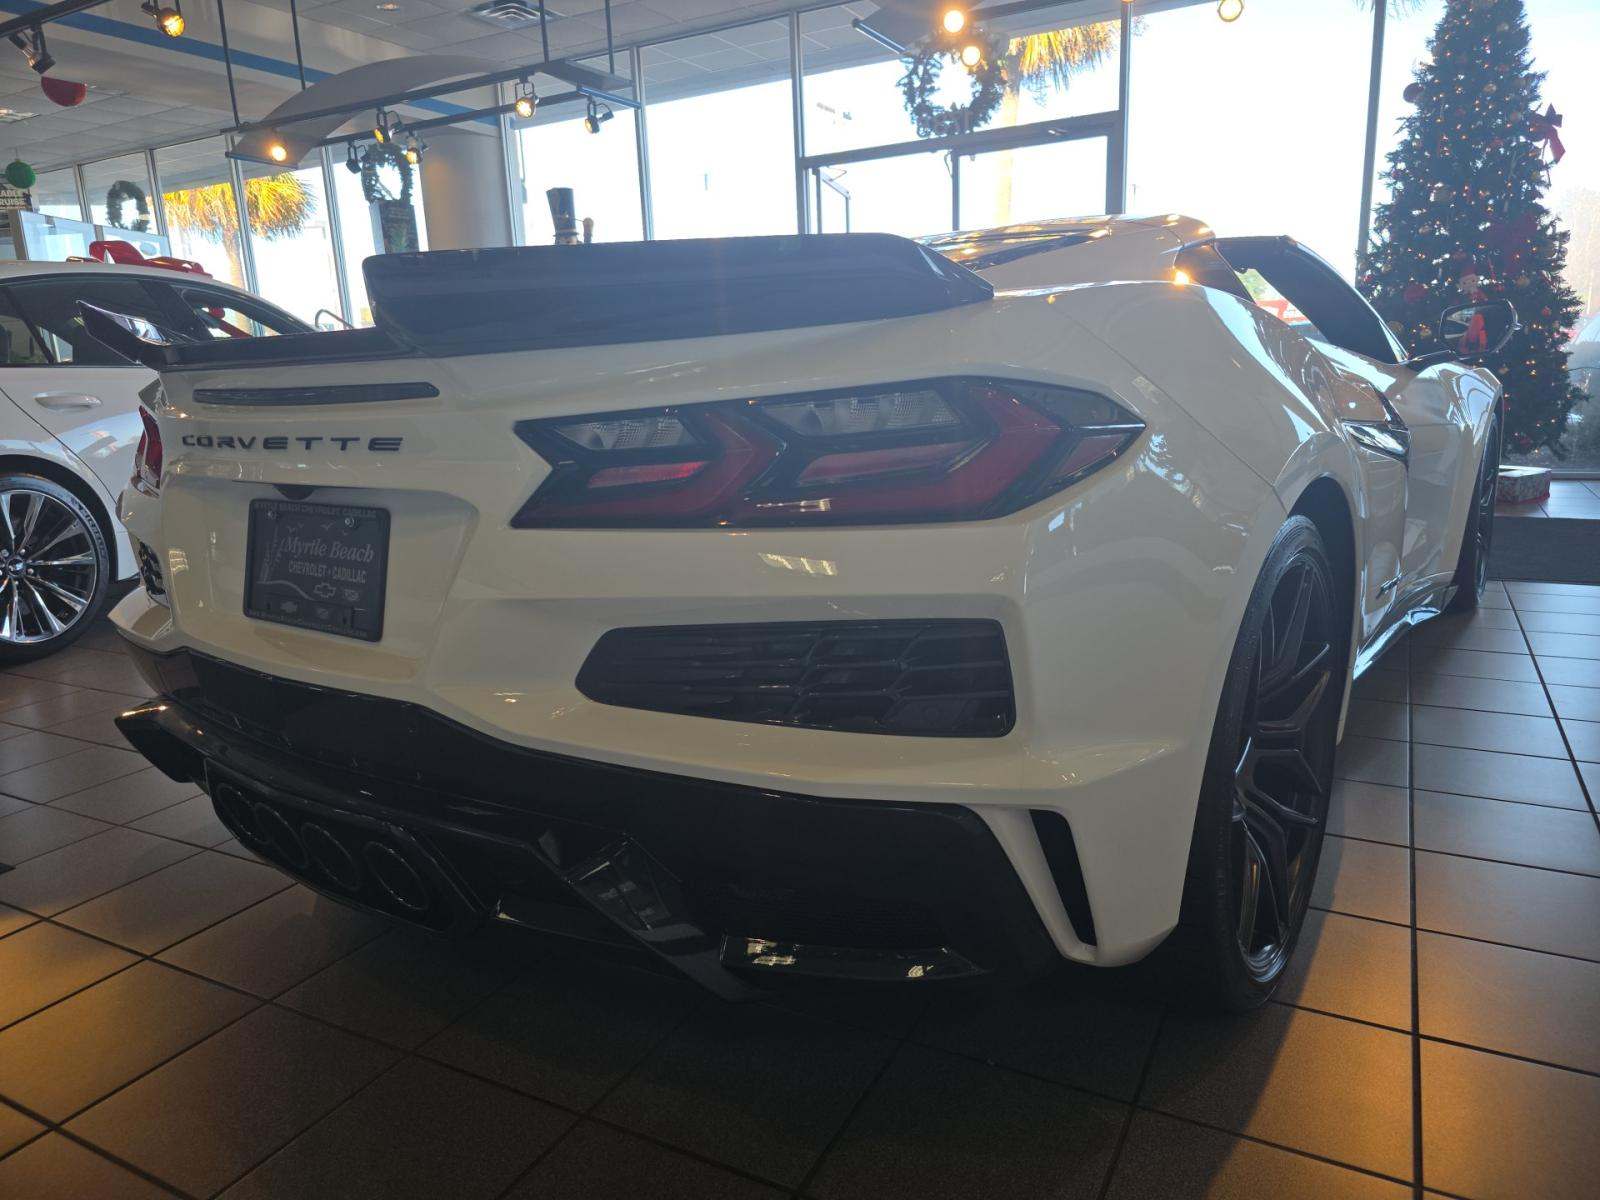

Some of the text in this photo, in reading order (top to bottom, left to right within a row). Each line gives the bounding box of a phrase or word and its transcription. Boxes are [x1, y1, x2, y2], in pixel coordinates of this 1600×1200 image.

[182, 434, 404, 451] CORVETTE
[280, 536, 375, 563] Myrtle Beach
[288, 560, 368, 584] CHEVROLET CADILLAC
